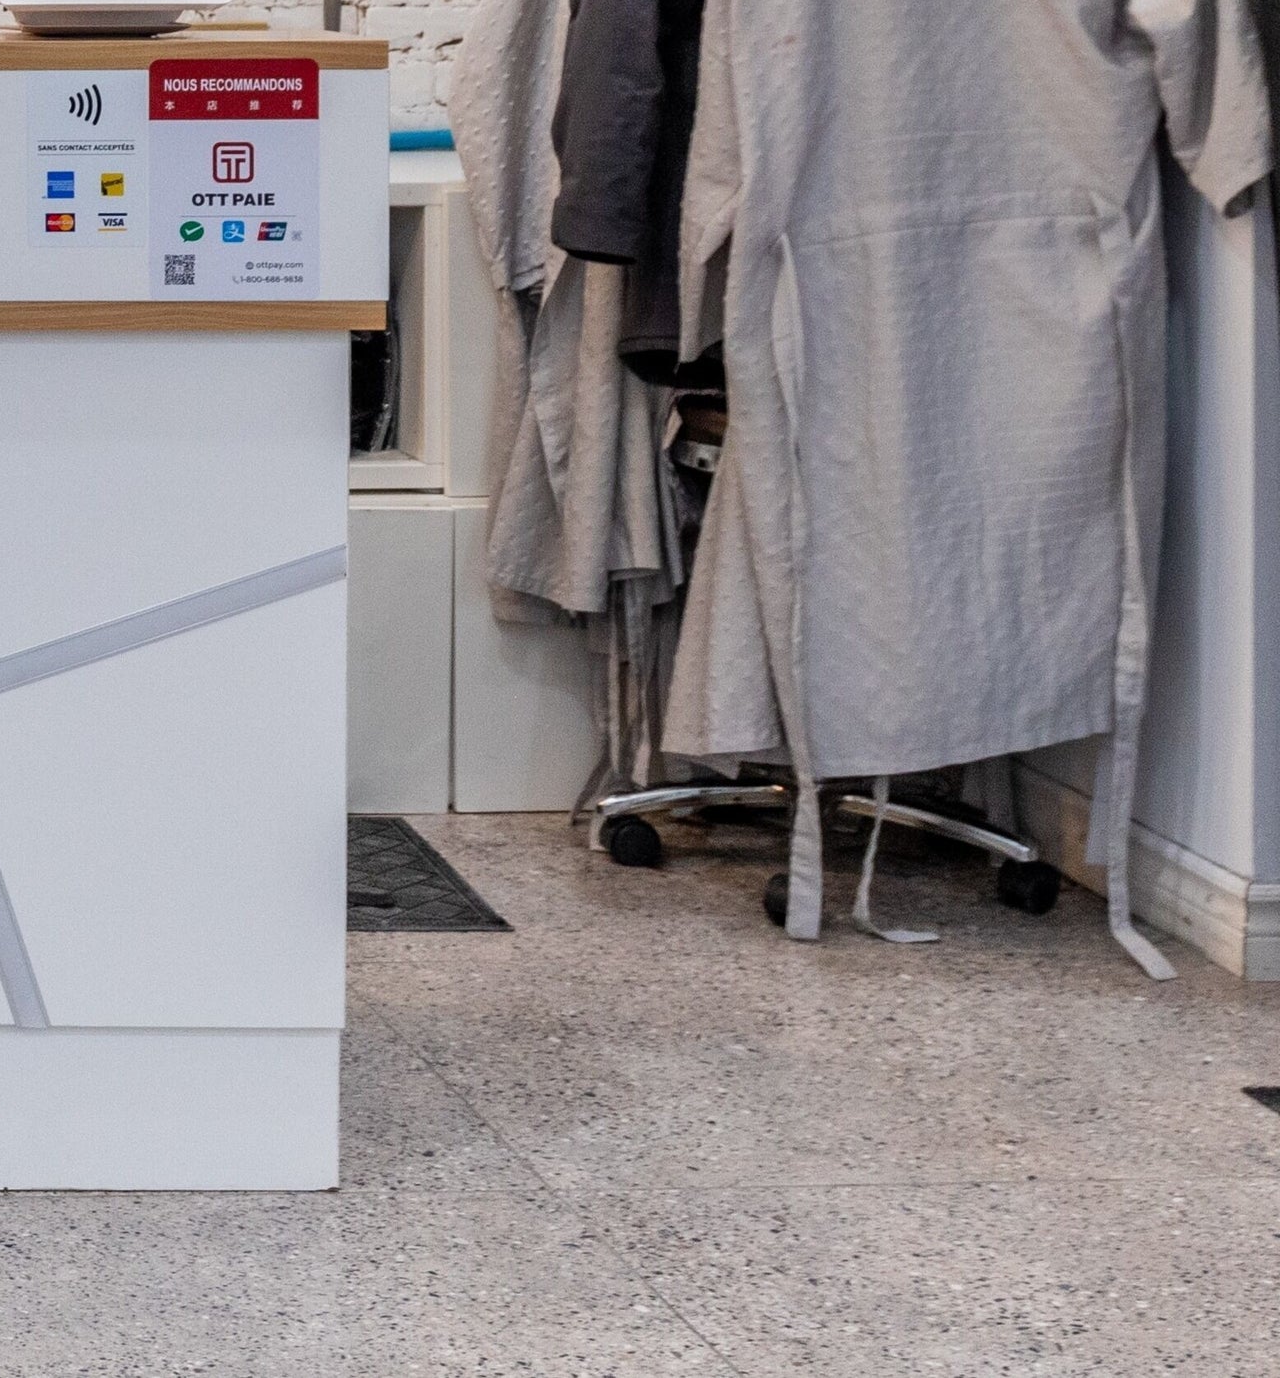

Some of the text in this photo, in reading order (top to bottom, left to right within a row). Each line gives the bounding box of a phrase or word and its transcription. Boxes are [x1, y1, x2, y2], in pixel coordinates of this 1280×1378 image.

[164, 78, 303, 91] NOUS RECOMMANDONS
[94, 143, 134, 151] ACCEPTÉES
[192, 193, 275, 206] OTT PAIE
[256, 262, 303, 270] ottpay.com
